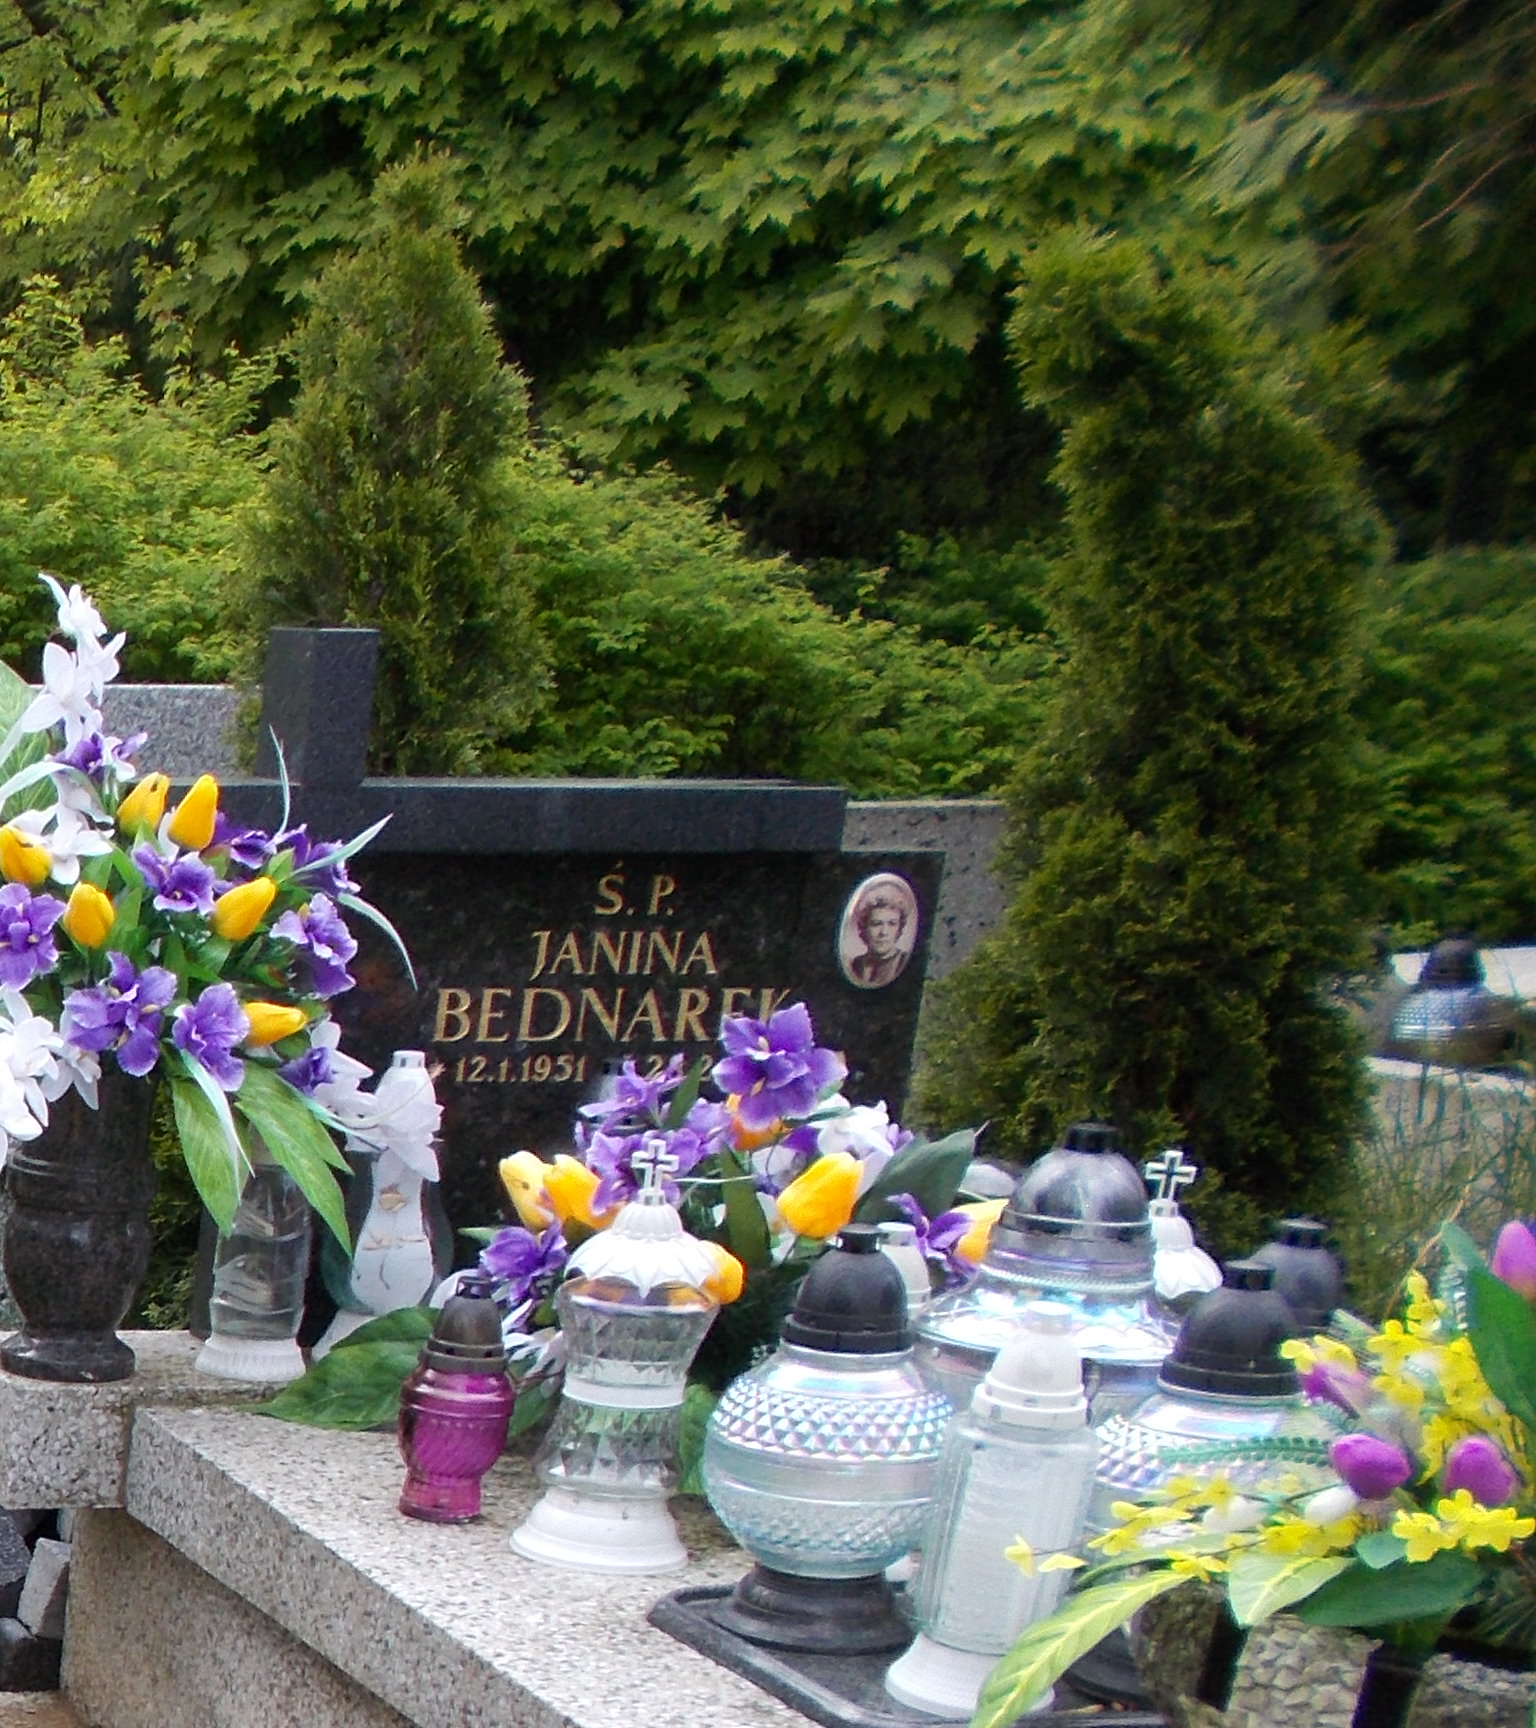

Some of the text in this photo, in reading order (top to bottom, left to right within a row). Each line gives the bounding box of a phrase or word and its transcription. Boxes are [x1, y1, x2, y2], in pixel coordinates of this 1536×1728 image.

[647, 874, 676, 916] P.
[529, 930, 718, 982] JANINA
[455, 1055, 587, 1083] 12.1.1951
